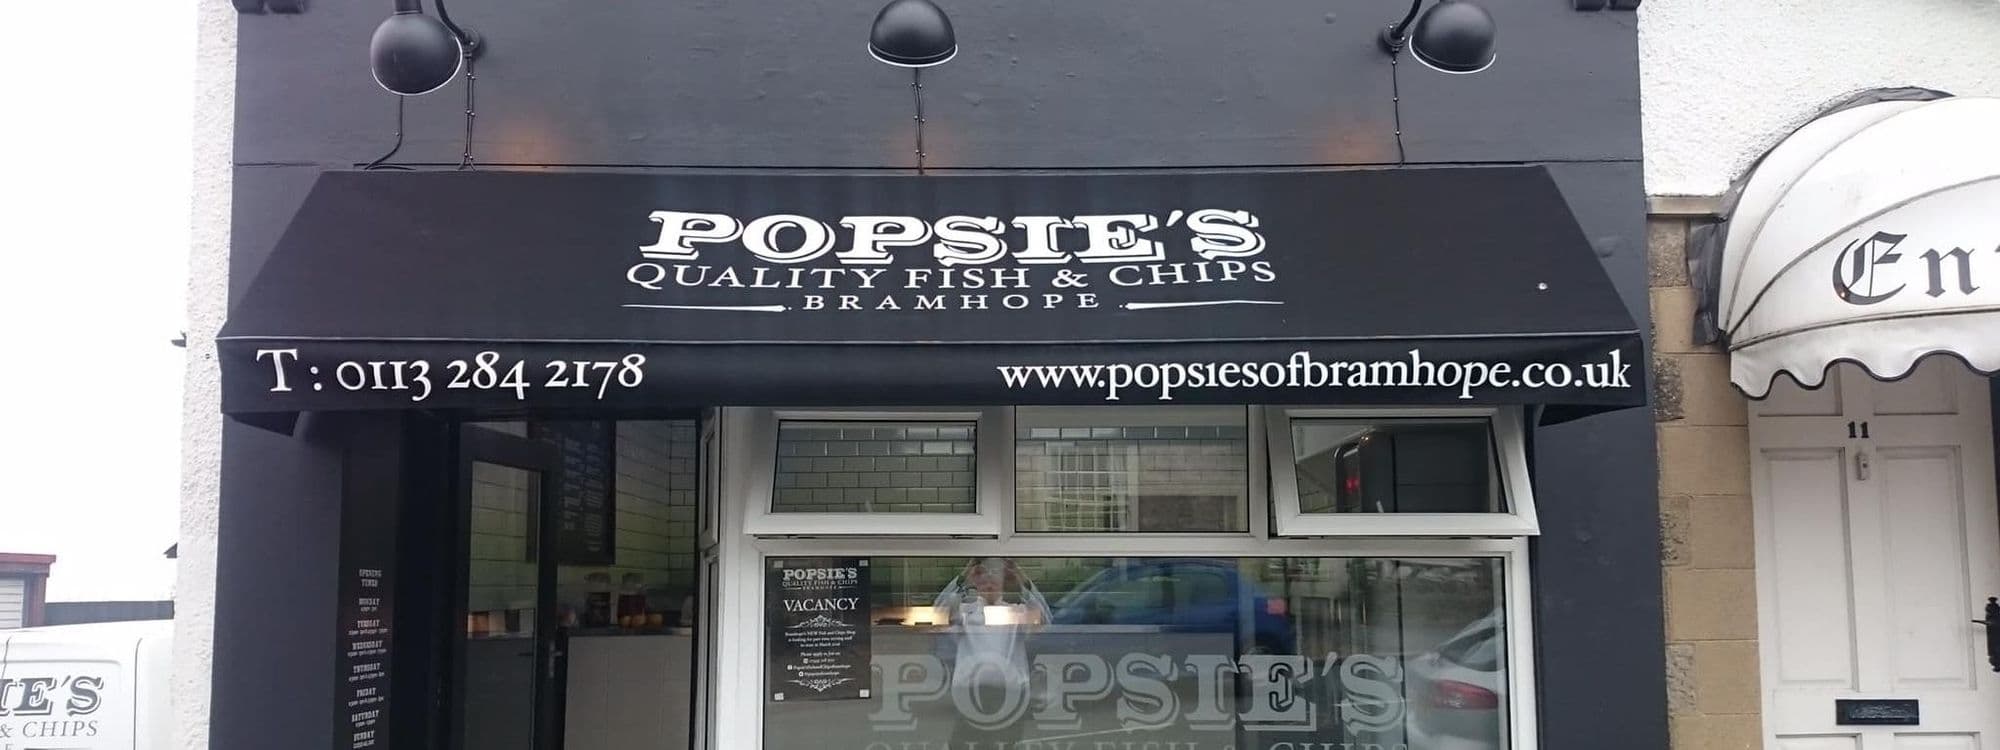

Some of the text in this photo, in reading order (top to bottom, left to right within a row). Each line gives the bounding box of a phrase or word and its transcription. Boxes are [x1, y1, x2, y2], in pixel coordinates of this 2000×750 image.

[639, 209, 1266, 265] POPSIE'S
[626, 259, 1277, 290] QUALITY FISH & CHIPS
[1832, 231, 2000, 306] En
[802, 292, 1100, 310] BRAMHOPE
[336, 359, 432, 402] 0113
[446, 350, 531, 400] 284
[544, 353, 647, 400] 2178
[997, 349, 1631, 401] www.popsiesofbramhope.co.uk
[1847, 421, 1870, 439] 11
[783, 567, 858, 581] POPSIE'S
[783, 597, 859, 612] VACANCY
[867, 652, 1406, 735] POPSIE'S
[22, 720, 98, 738] CHIPS
